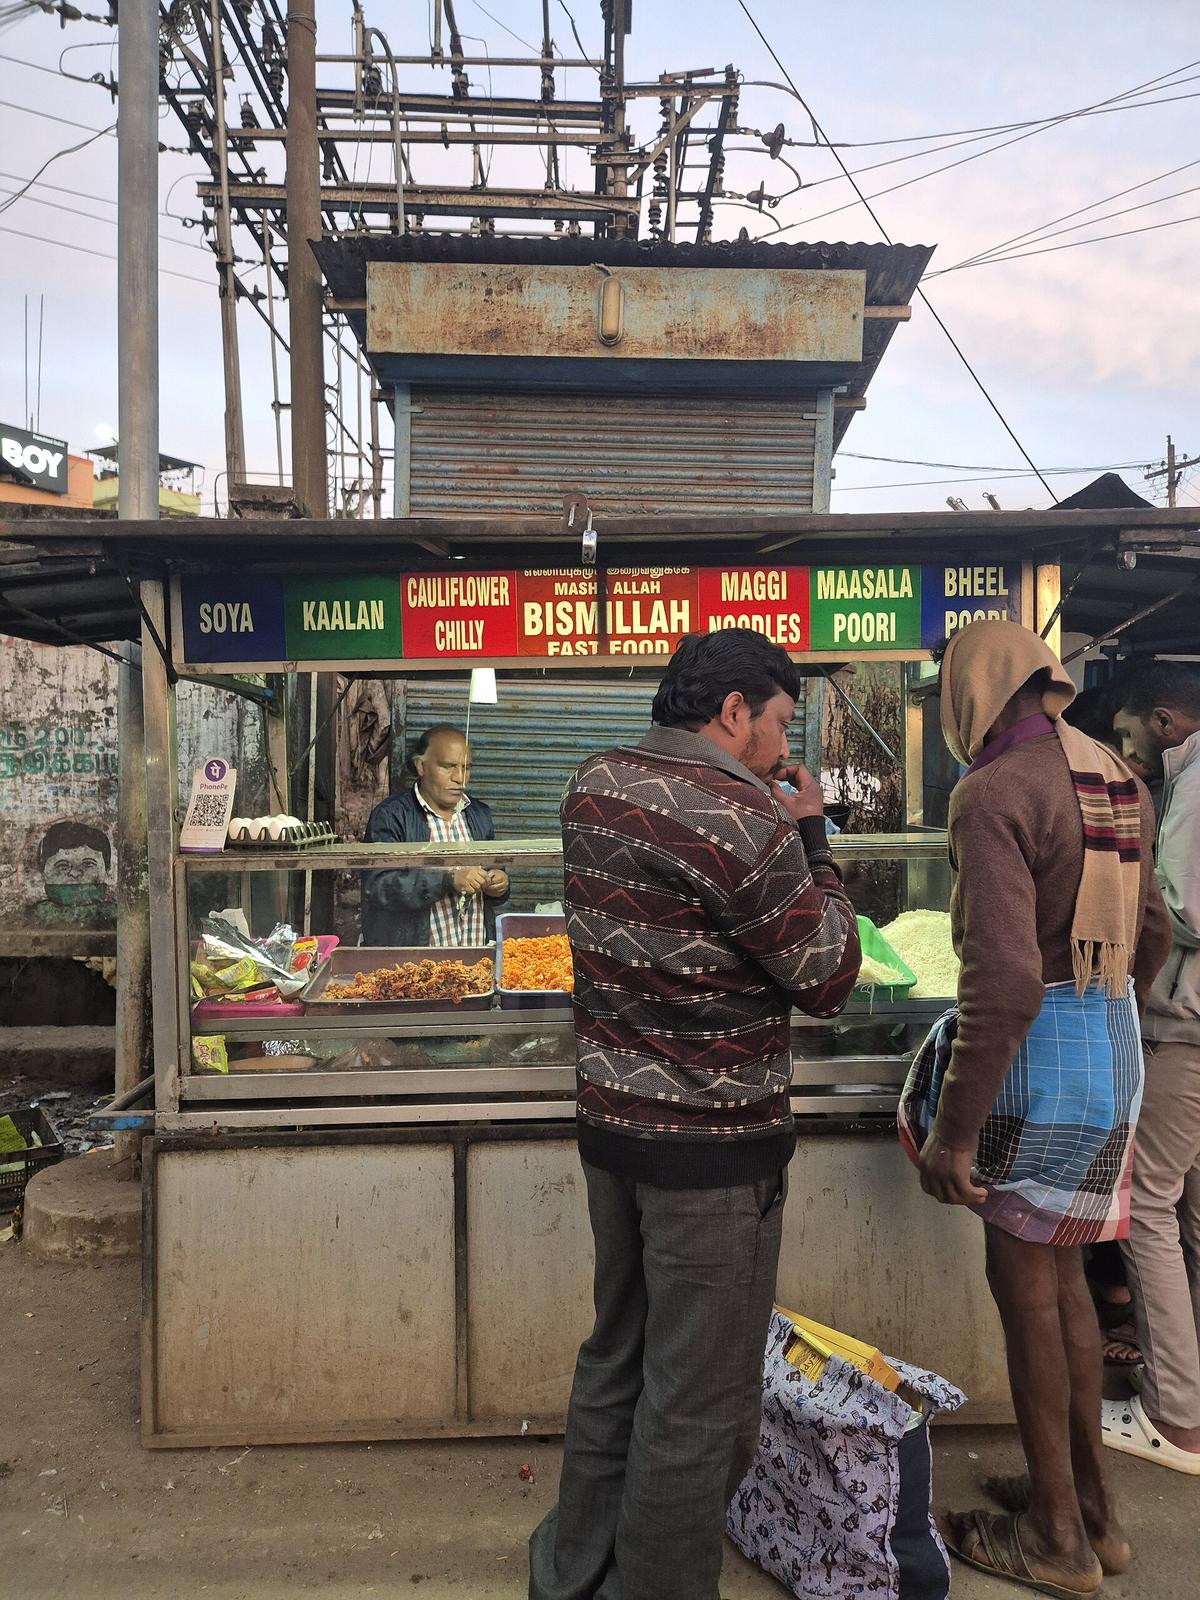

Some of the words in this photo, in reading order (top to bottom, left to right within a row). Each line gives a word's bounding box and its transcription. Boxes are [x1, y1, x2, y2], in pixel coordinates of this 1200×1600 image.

[2, 437, 64, 479] BOY
[407, 576, 510, 608] CAULIFLOWER
[613, 580, 661, 595] ALLAH
[721, 570, 787, 601] MAGGI
[817, 569, 913, 600] MAASALA
[944, 566, 1009, 597] BHEEL
[199, 602, 254, 634] SOYA
[302, 600, 385, 631] KAALAN
[523, 599, 690, 636] BISMILLAH
[833, 611, 896, 643] POORI
[434, 620, 484, 652] CHILLY
[547, 640, 599, 656] FAST
[609, 639, 670, 656] FOOD
[199, 783, 228, 791] PhonePe
